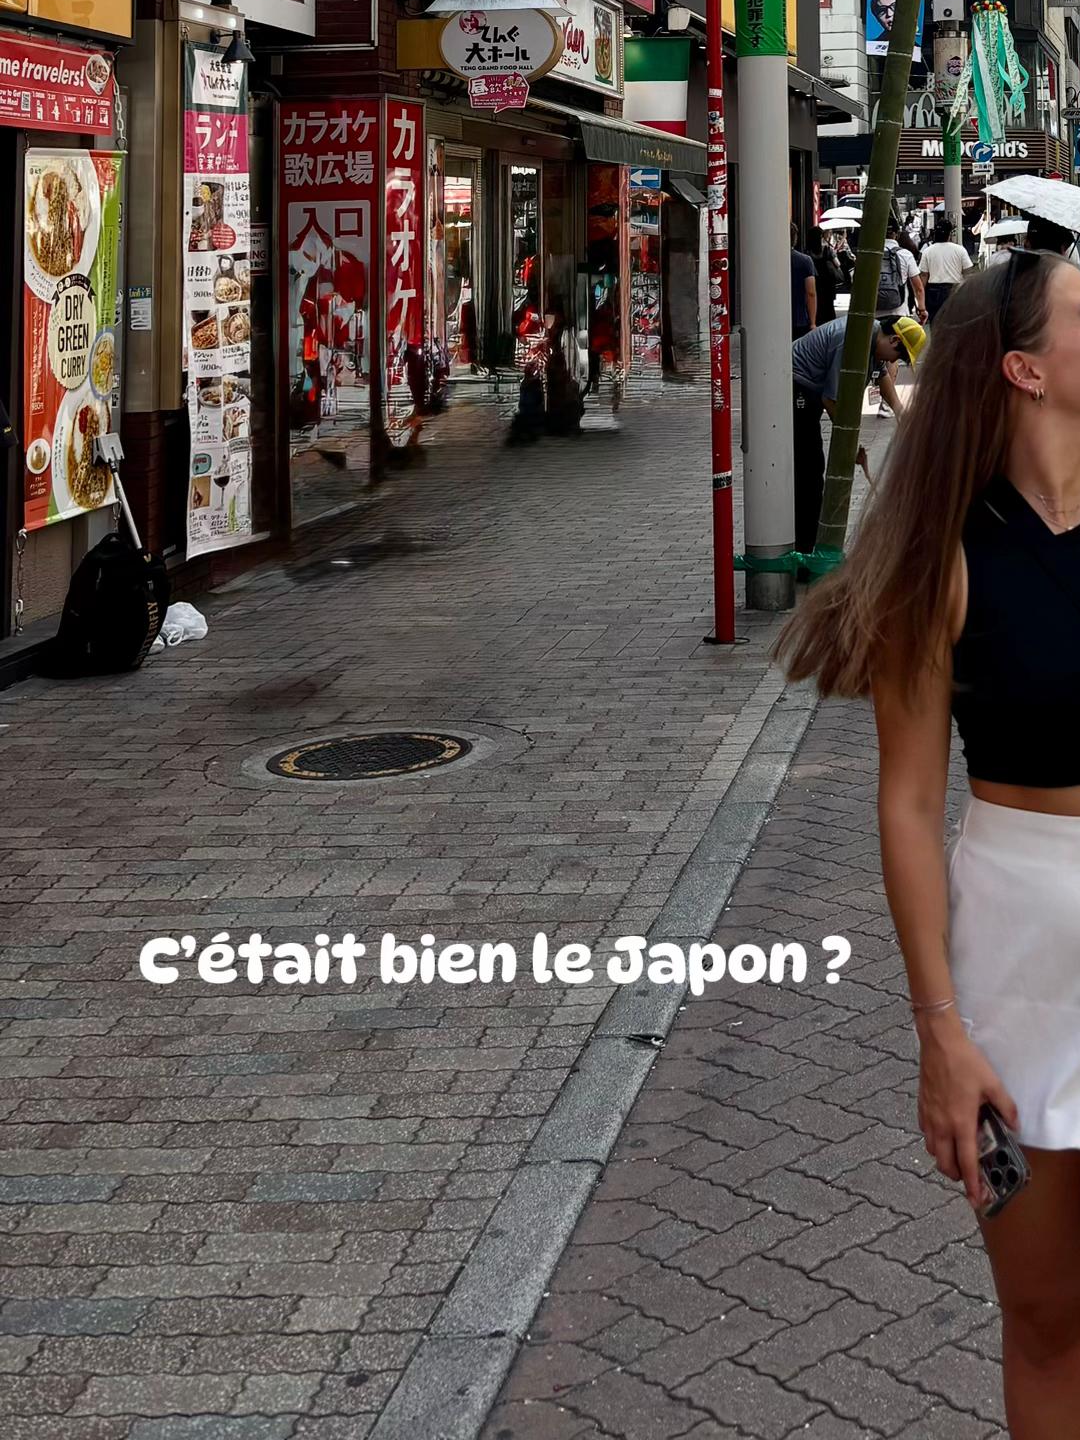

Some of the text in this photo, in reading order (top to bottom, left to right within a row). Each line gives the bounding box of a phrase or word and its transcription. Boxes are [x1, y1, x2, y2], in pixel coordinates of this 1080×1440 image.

[478, 25, 520, 44] てんぐ
[465, 42, 531, 64] 大ホール
[21, 57, 86, 88] travelers!
[194, 114, 239, 151] ランチ
[283, 110, 377, 146] カラオケ
[283, 150, 375, 187] 歌広場
[289, 206, 364, 252] 入口
[391, 108, 417, 352] カラオケ
[65, 293, 85, 322] DRY
[57, 323, 89, 353] GREEN
[61, 355, 86, 379] CURRY
